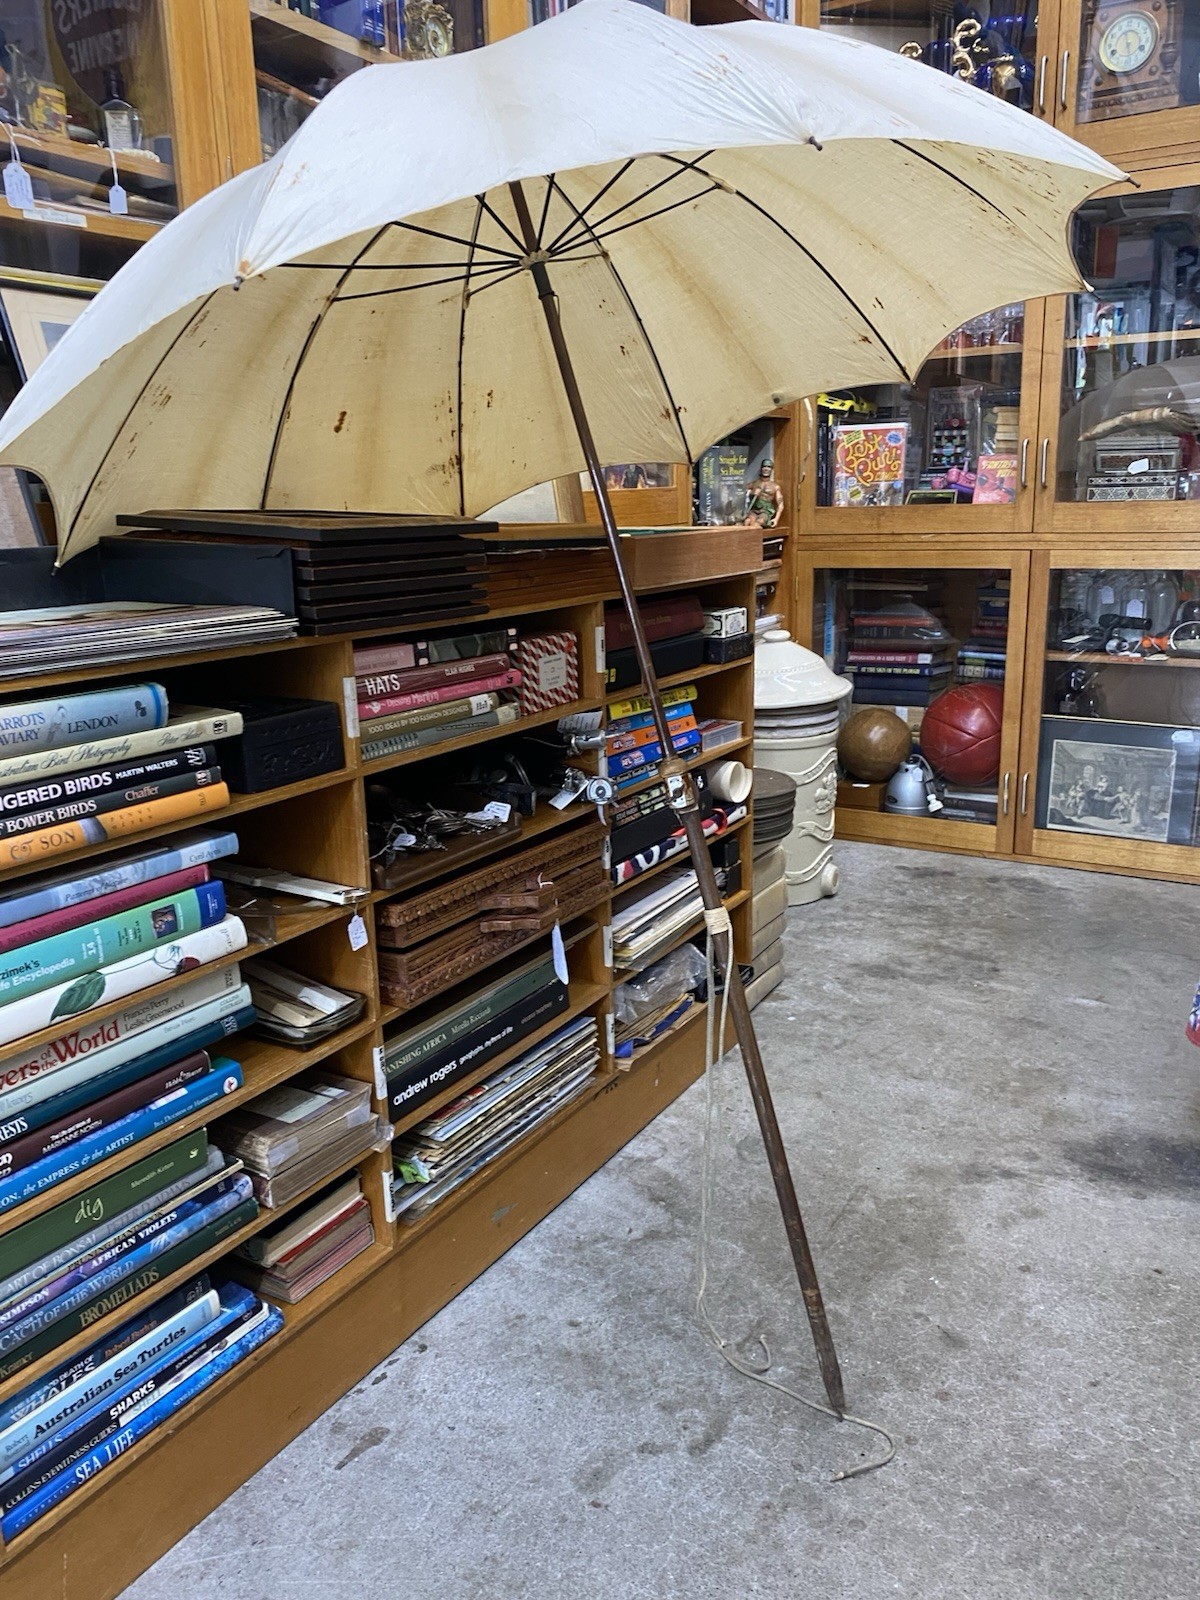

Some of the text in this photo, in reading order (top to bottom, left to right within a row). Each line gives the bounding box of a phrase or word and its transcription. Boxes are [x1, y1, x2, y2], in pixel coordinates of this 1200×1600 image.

[364, 673, 400, 696] HATS
[67, 714, 119, 734] LENDON
[368, 725, 384, 734] 1000
[384, 721, 400, 731] IDEAS
[409, 716, 420, 725] 100
[383, 732, 419, 748] DRESSED
[63, 771, 113, 795] BIRDS
[115, 766, 145, 780] MARTIN
[146, 758, 179, 773] WALTERS
[5, 784, 160, 833] BOWER BIRDS Chaffer
[39, 830, 77, 851] SON
[0, 960, 40, 980] zimek's
[12, 958, 75, 987] Encyclopedia
[151, 996, 169, 1012] Perry
[41, 1048, 51, 1060] of
[48, 1019, 121, 1064] World
[422, 1032, 447, 1057] AFRICA
[41, 1059, 58, 1071] the
[393, 1075, 428, 1107] andrew
[429, 1059, 458, 1086] rogers
[23, 1183, 36, 1196] the
[37, 1160, 80, 1188] EMPRESS
[91, 1149, 103, 1161] the
[105, 1132, 135, 1154] ARTIST
[74, 1195, 104, 1224] dig
[0, 1288, 50, 1323] SIMPSON
[90, 1235, 136, 1268] AFRICAN
[137, 1211, 178, 1238] VIOLETS
[6, 1272, 31, 1293] ART
[33, 1262, 49, 1280] OF
[52, 1233, 98, 1268] BONSAI
[0, 1259, 134, 1351] CACTI OF THE WORLD
[79, 1266, 160, 1329] BROMELIADS
[33, 1379, 113, 1440] Australian
[113, 1361, 138, 1387] Sea
[137, 1325, 187, 1364] Turtles
[58, 1361, 84, 1381] DEATH
[83, 1354, 95, 1365] OF
[10, 1361, 96, 1422] WHALES
[109, 1380, 156, 1420] SHARKS
[5, 1479, 42, 1509] COLLINS
[41, 1445, 91, 1484] EYEWITNESS
[89, 1422, 118, 1447] GUIDES
[18, 1434, 63, 1469] SHELLS
[75, 1455, 103, 1485] SEA
[105, 1427, 136, 1462] LIFE
